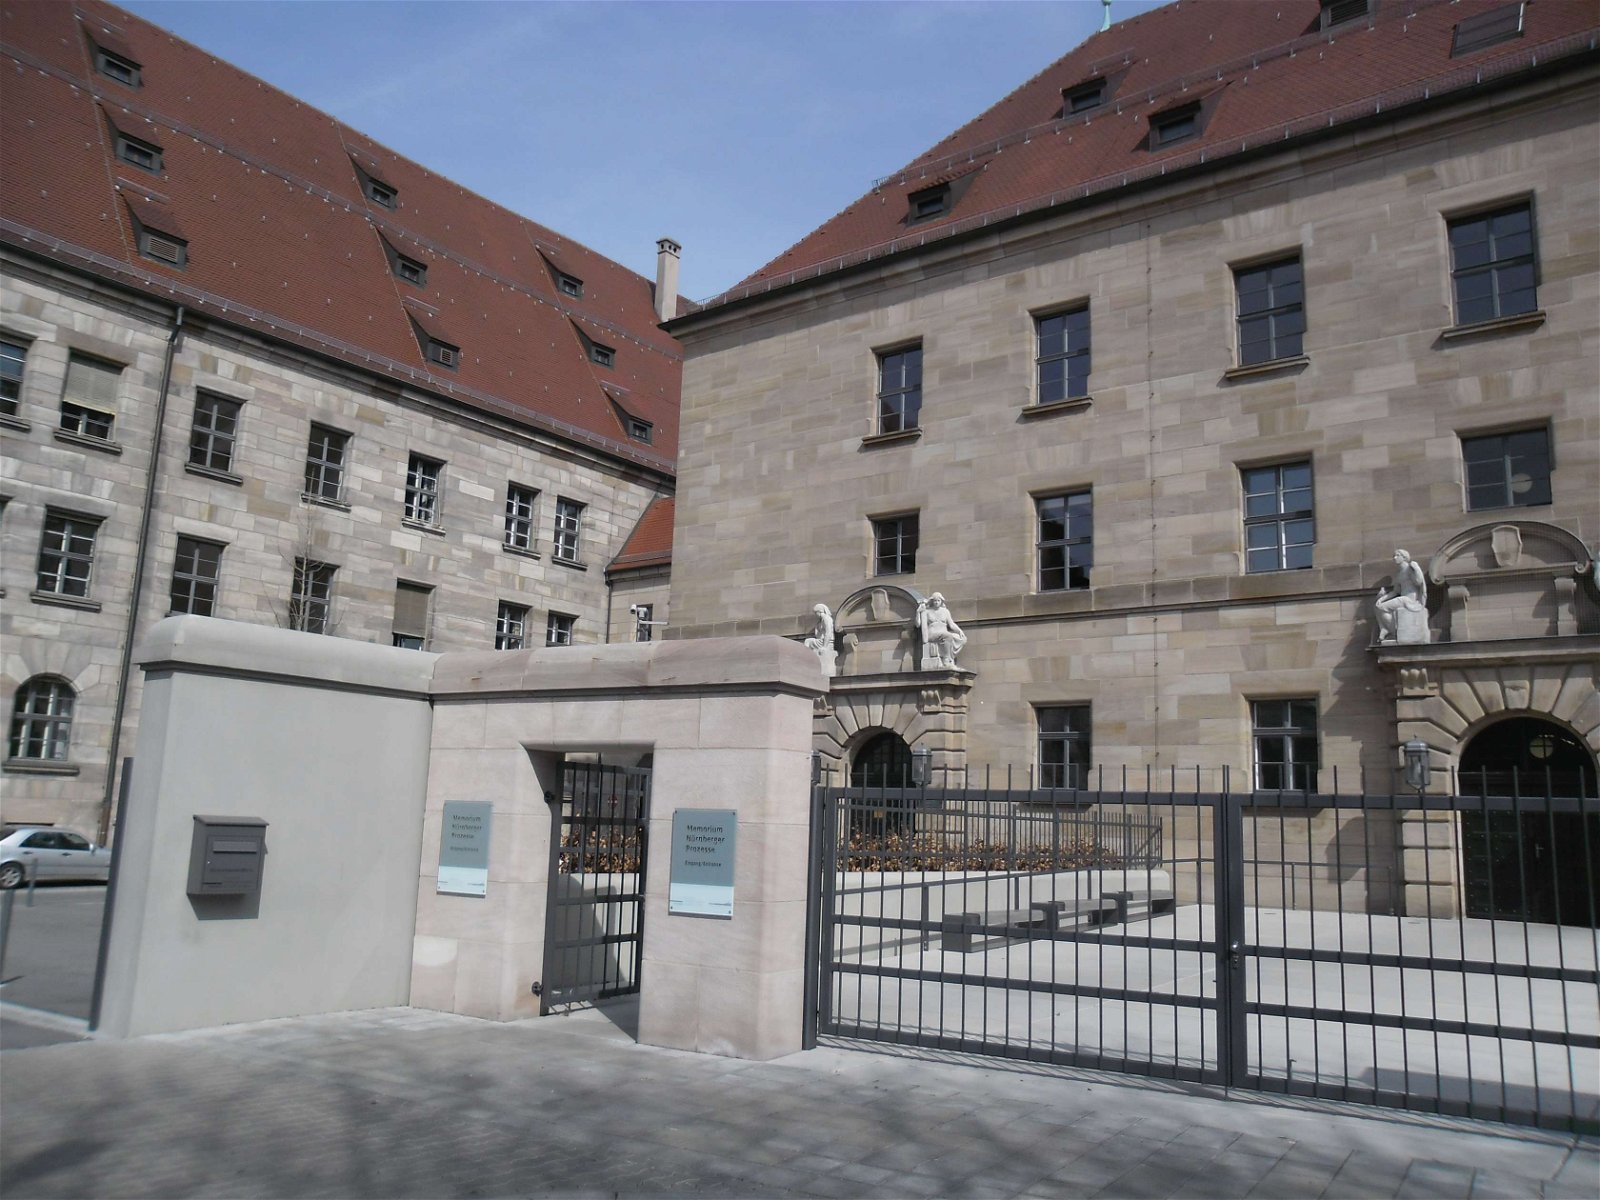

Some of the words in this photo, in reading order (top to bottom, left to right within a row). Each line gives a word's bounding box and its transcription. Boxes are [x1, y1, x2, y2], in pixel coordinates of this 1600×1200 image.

[687, 824, 723, 833] Memorium
[686, 834, 726, 845] Nürnberger
[685, 844, 716, 853] Prozesse
